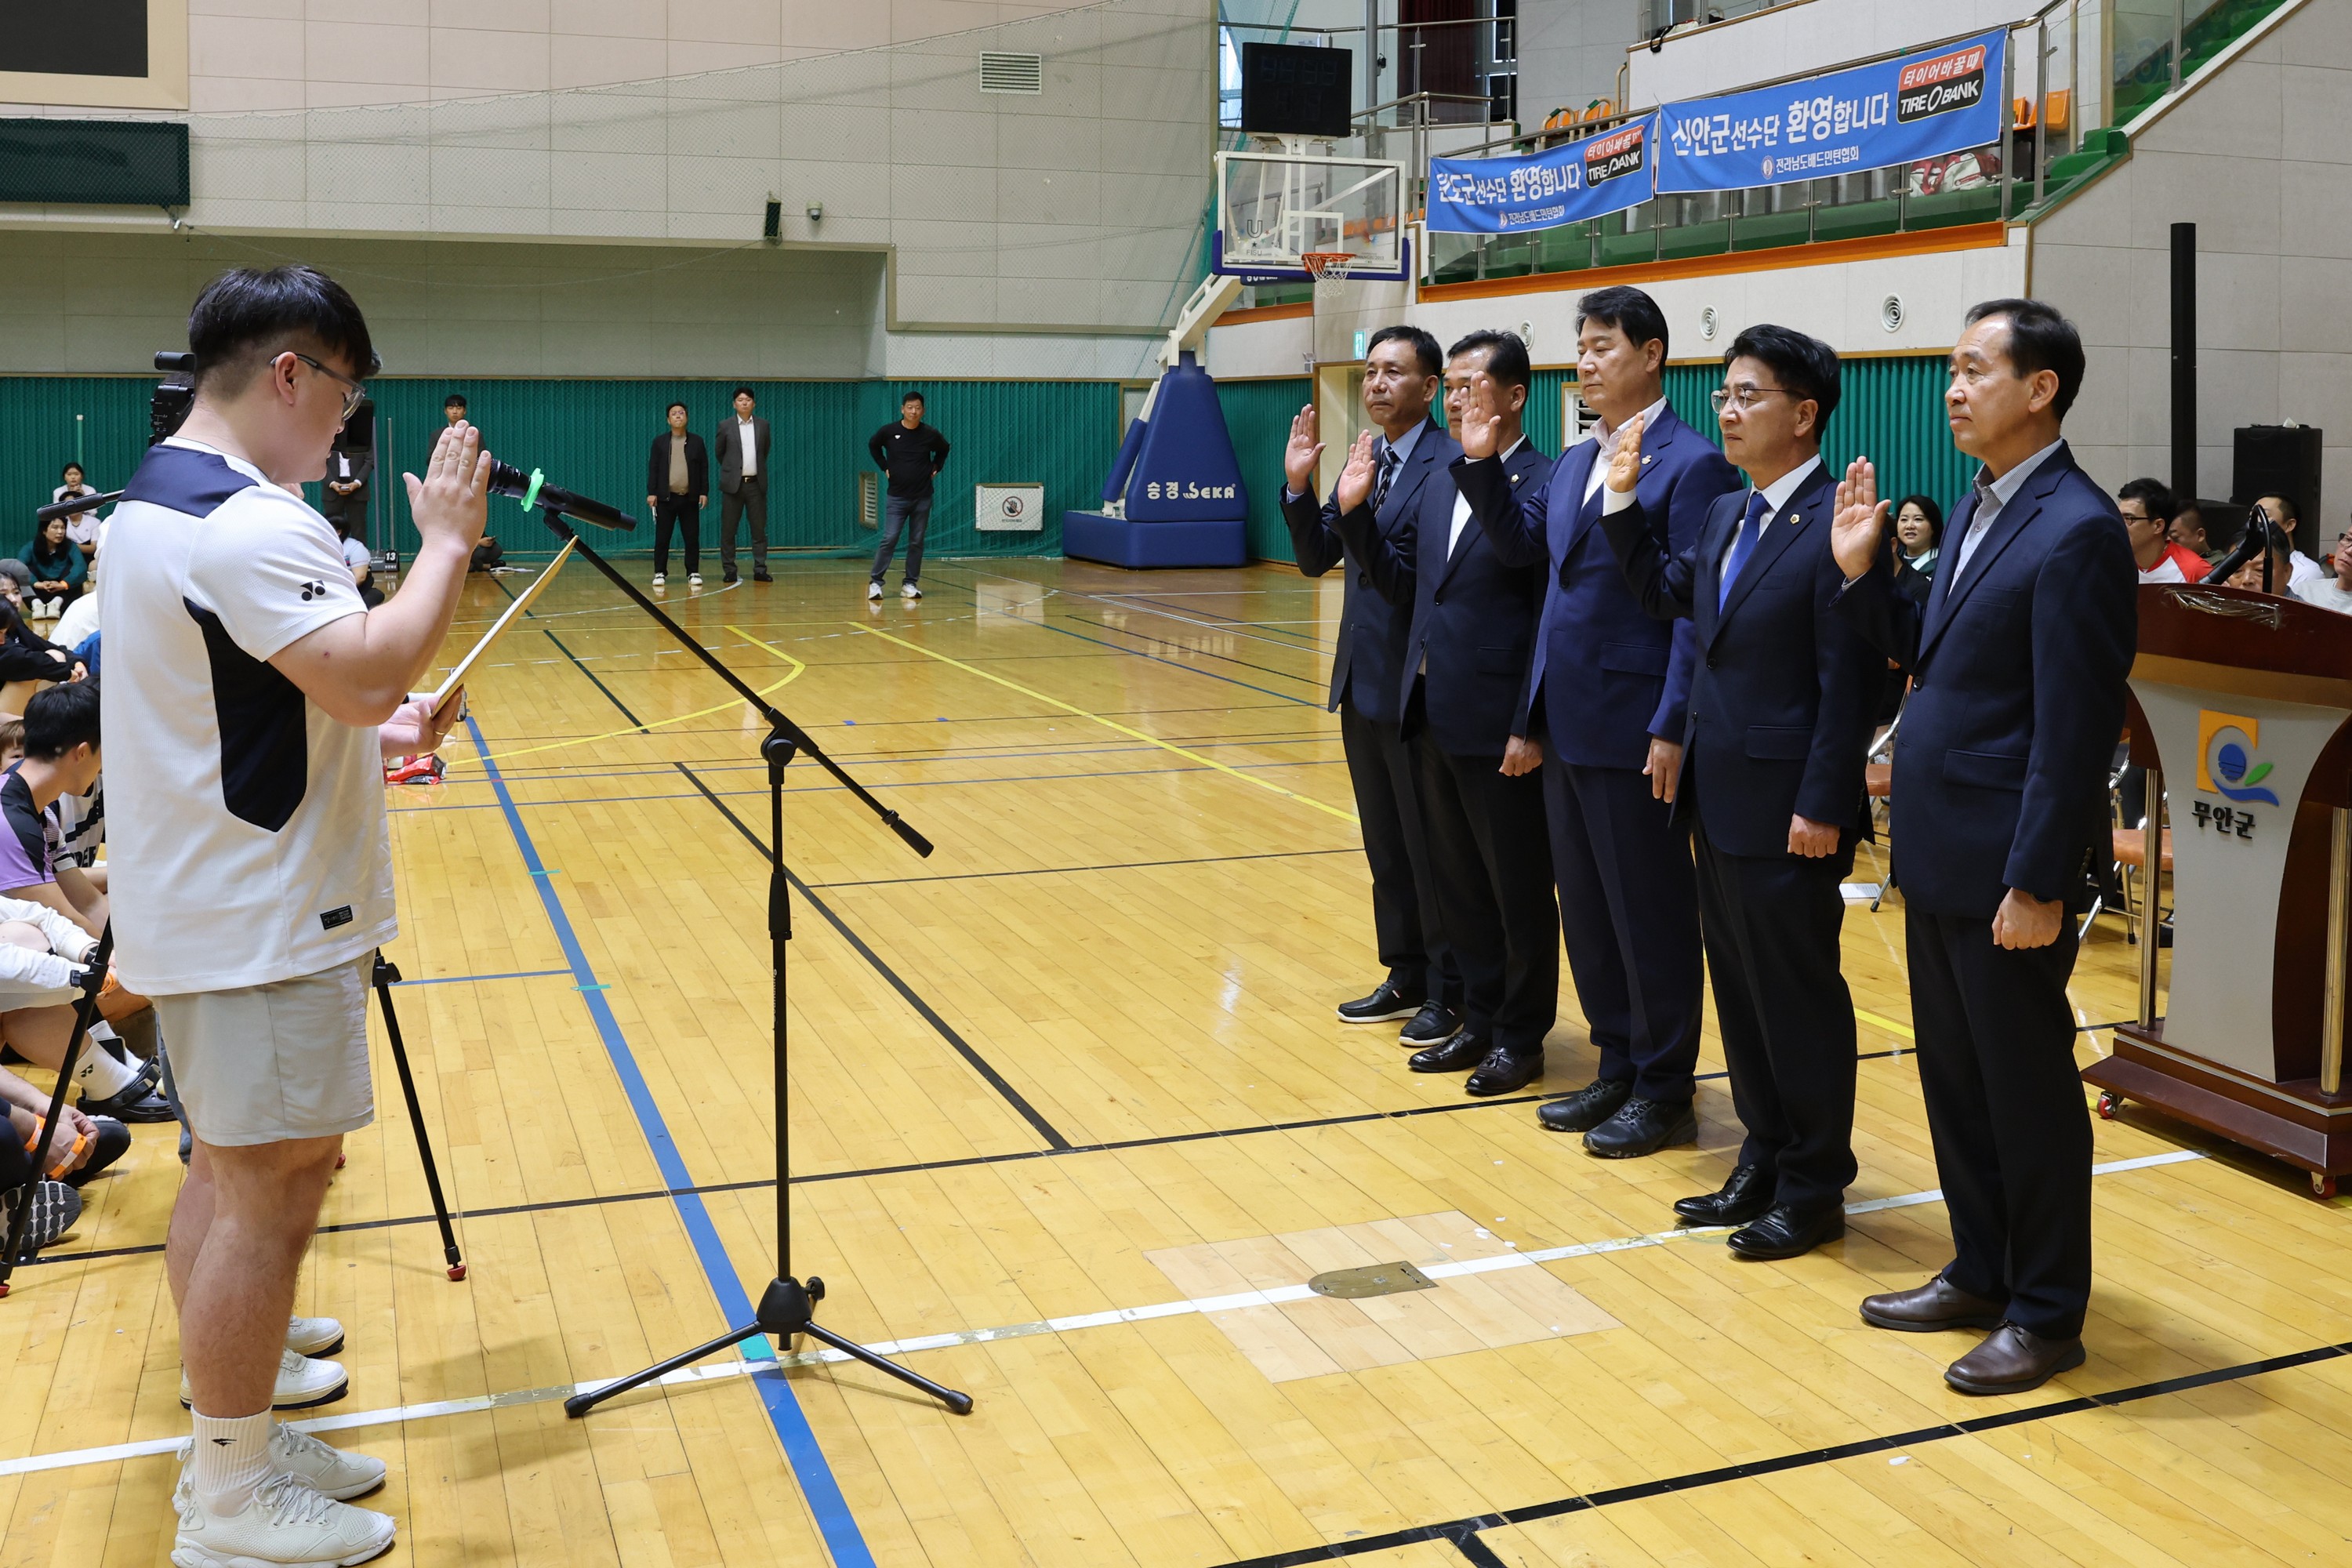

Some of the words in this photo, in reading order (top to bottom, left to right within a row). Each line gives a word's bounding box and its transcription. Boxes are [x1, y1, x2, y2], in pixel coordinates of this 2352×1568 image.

[1900, 94, 1928, 114] TIRE
[1941, 79, 1980, 104] BANK
[1786, 92, 1889, 143] 환영합니다
[1588, 165, 1607, 181] TIRE
[1776, 145, 1859, 173] 전라남도배드민턴협회
[1510, 163, 1581, 202] 환영합니다
[386, 552, 396, 561] 13
[2191, 800, 2256, 840] 무안군
